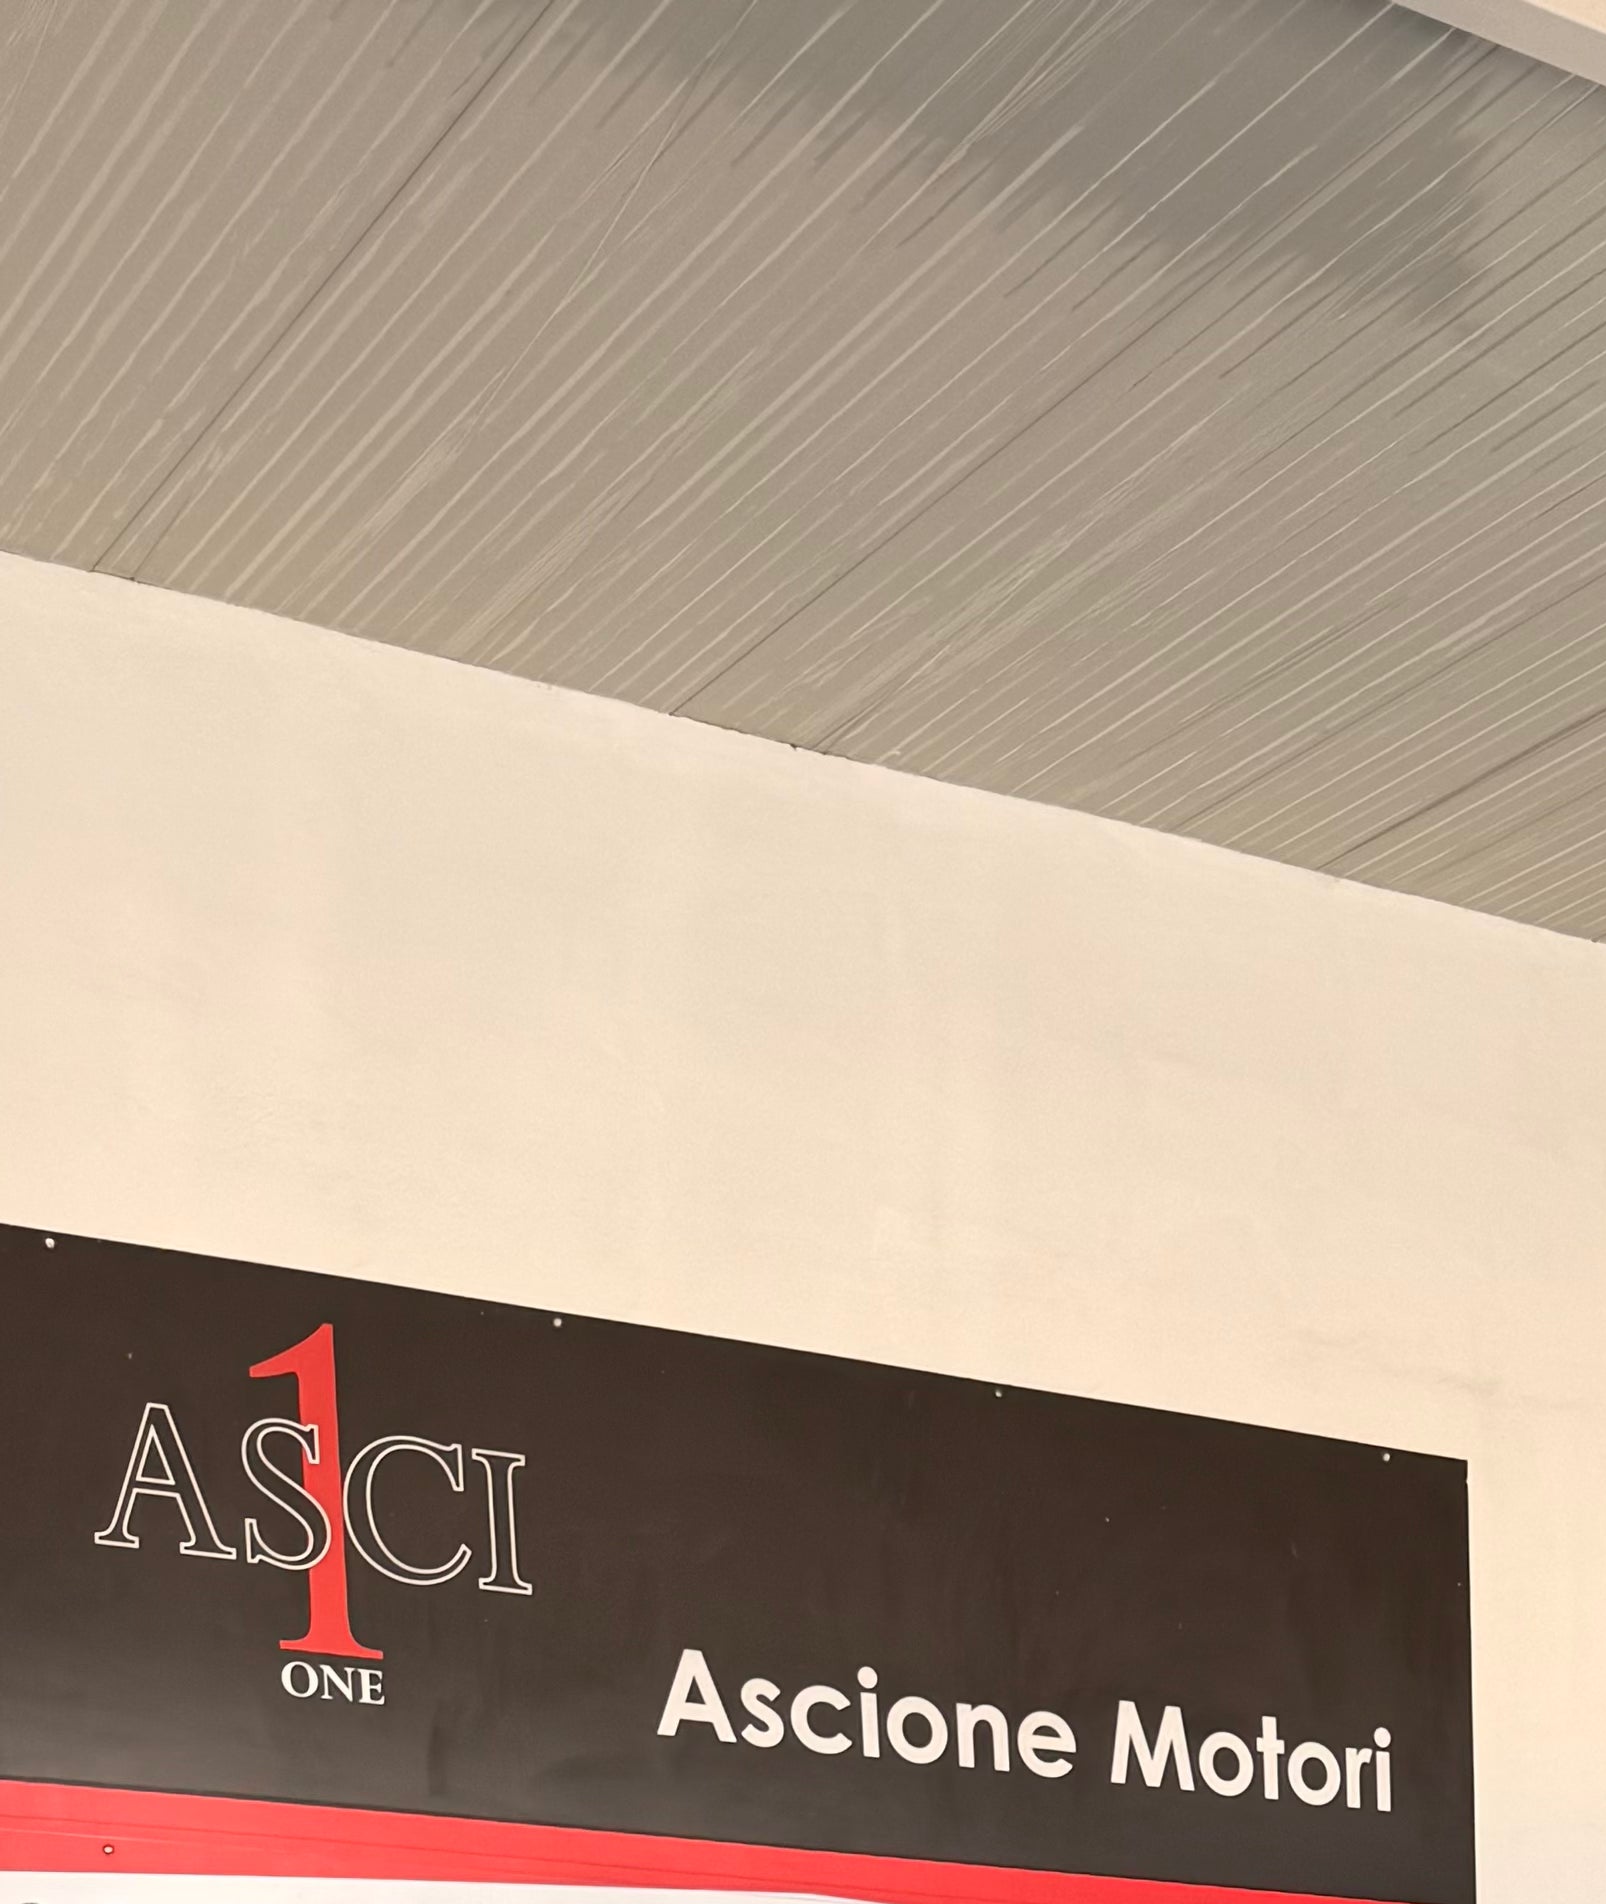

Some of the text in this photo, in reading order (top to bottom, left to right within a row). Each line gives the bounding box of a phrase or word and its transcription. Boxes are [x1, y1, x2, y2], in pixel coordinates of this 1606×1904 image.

[94, 1402, 533, 1596] ASCI
[280, 1659, 386, 1706] ONE
[657, 1647, 1393, 1812] Ascione Motori
